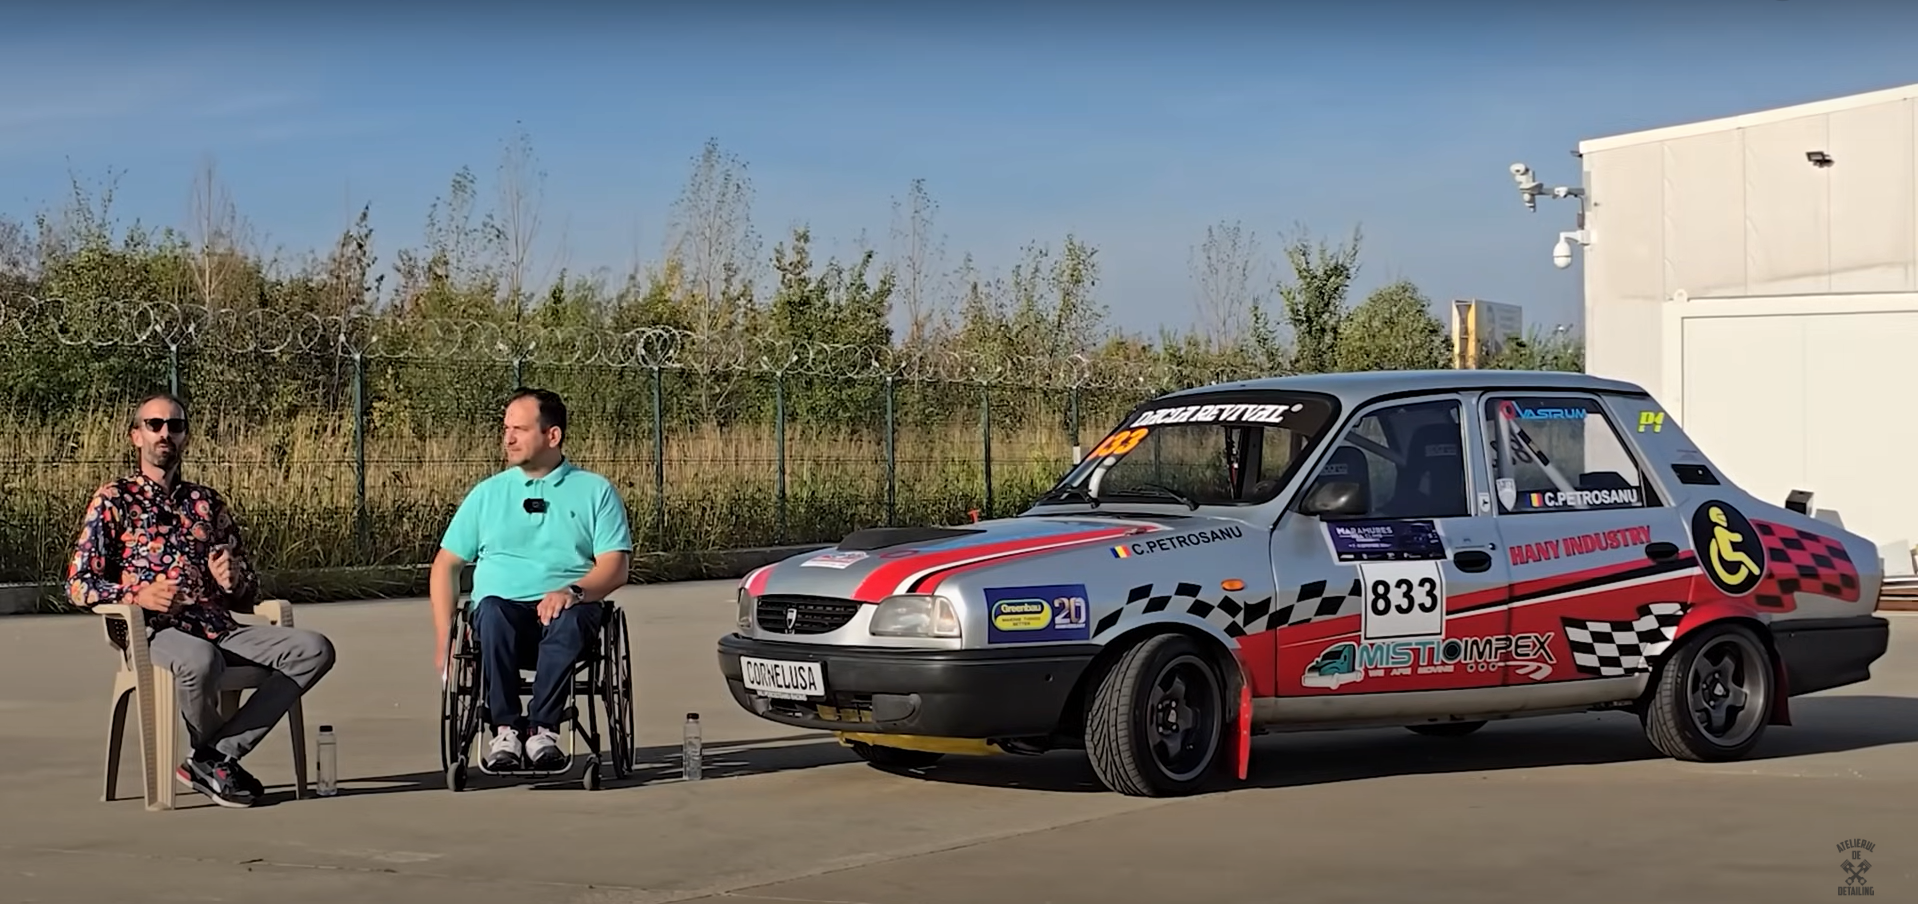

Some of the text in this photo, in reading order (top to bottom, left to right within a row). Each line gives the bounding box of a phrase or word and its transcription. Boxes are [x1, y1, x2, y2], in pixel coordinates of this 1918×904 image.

[1129, 403, 1290, 428] DACIA REVIVAL
[1544, 488, 1638, 507] C.PETROSANU
[1131, 526, 1243, 556] C.PETROSANU
[1509, 524, 1651, 566] HANY INDUSTRY
[1053, 597, 1087, 624] 20
[1371, 577, 1438, 616] 833
[746, 660, 817, 691] CORNELUSA
